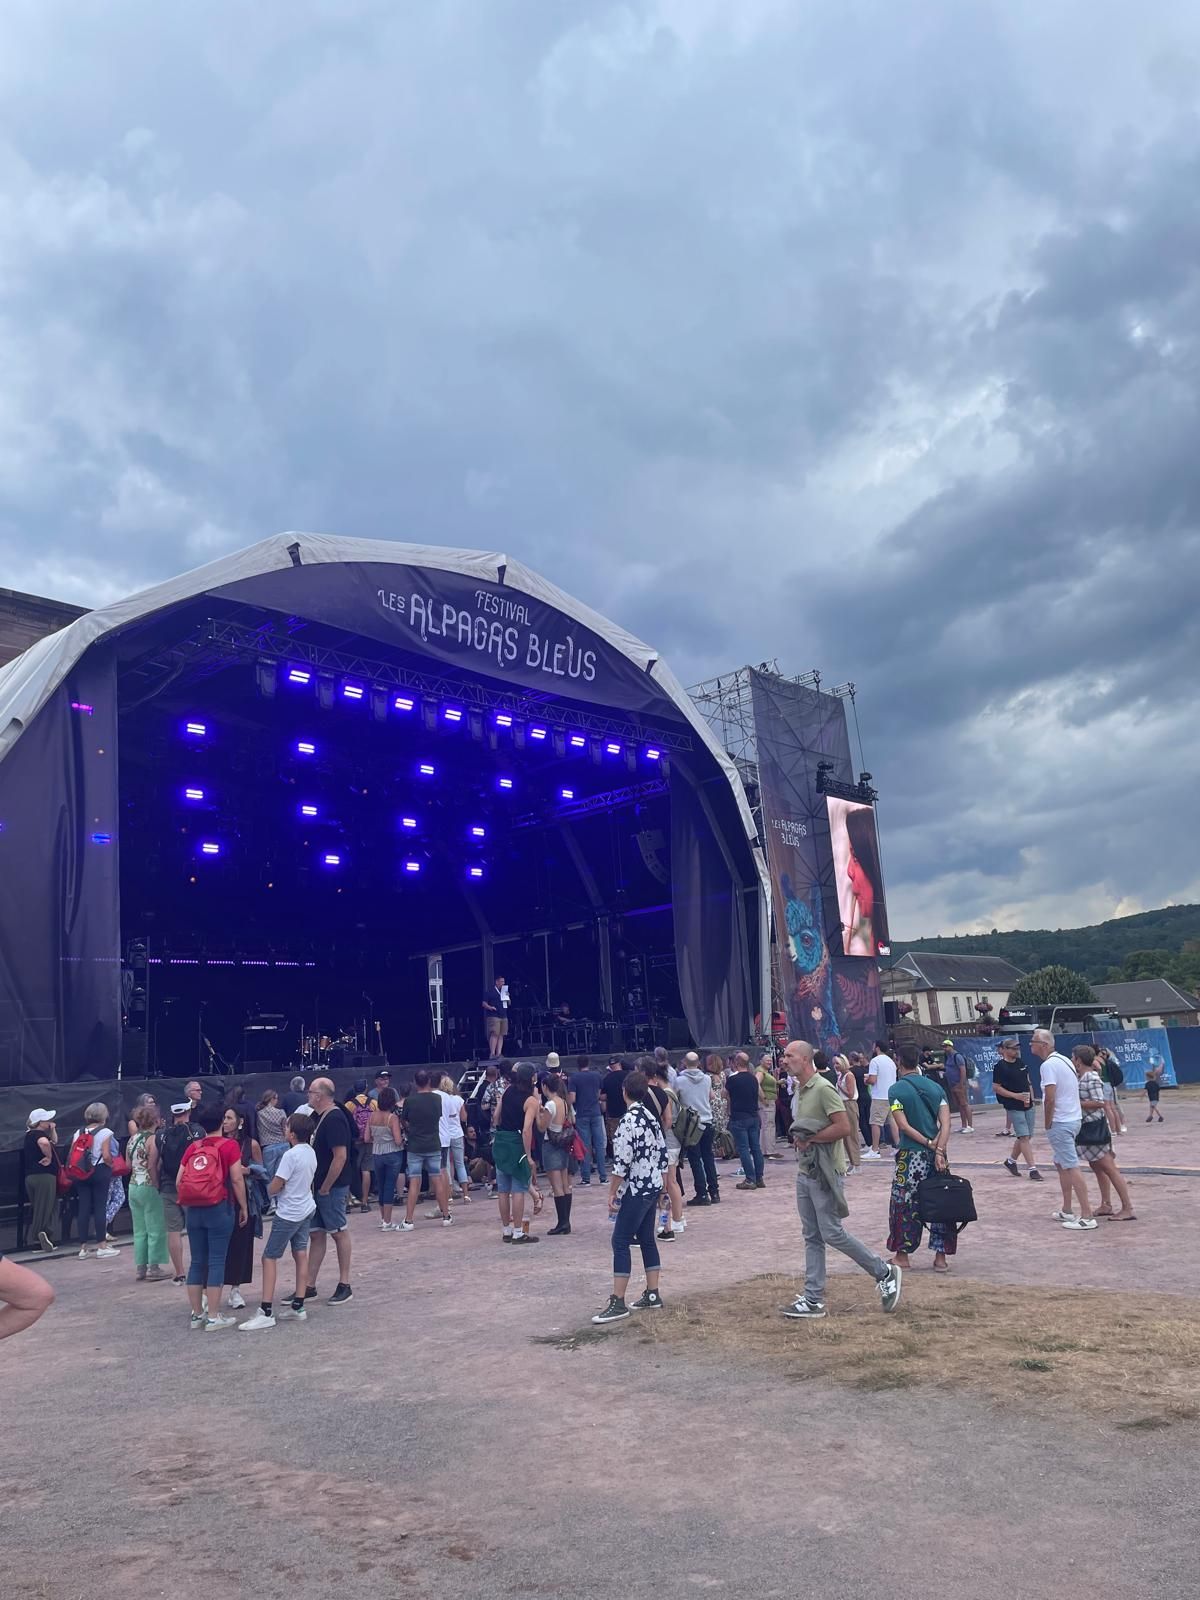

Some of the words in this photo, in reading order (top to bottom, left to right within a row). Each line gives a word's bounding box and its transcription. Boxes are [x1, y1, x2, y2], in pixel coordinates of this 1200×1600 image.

[377, 589, 406, 614] LES
[409, 593, 519, 667] ALPAGAS
[526, 633, 597, 681] BLEUS
[475, 590, 531, 626] FESTIVAL
